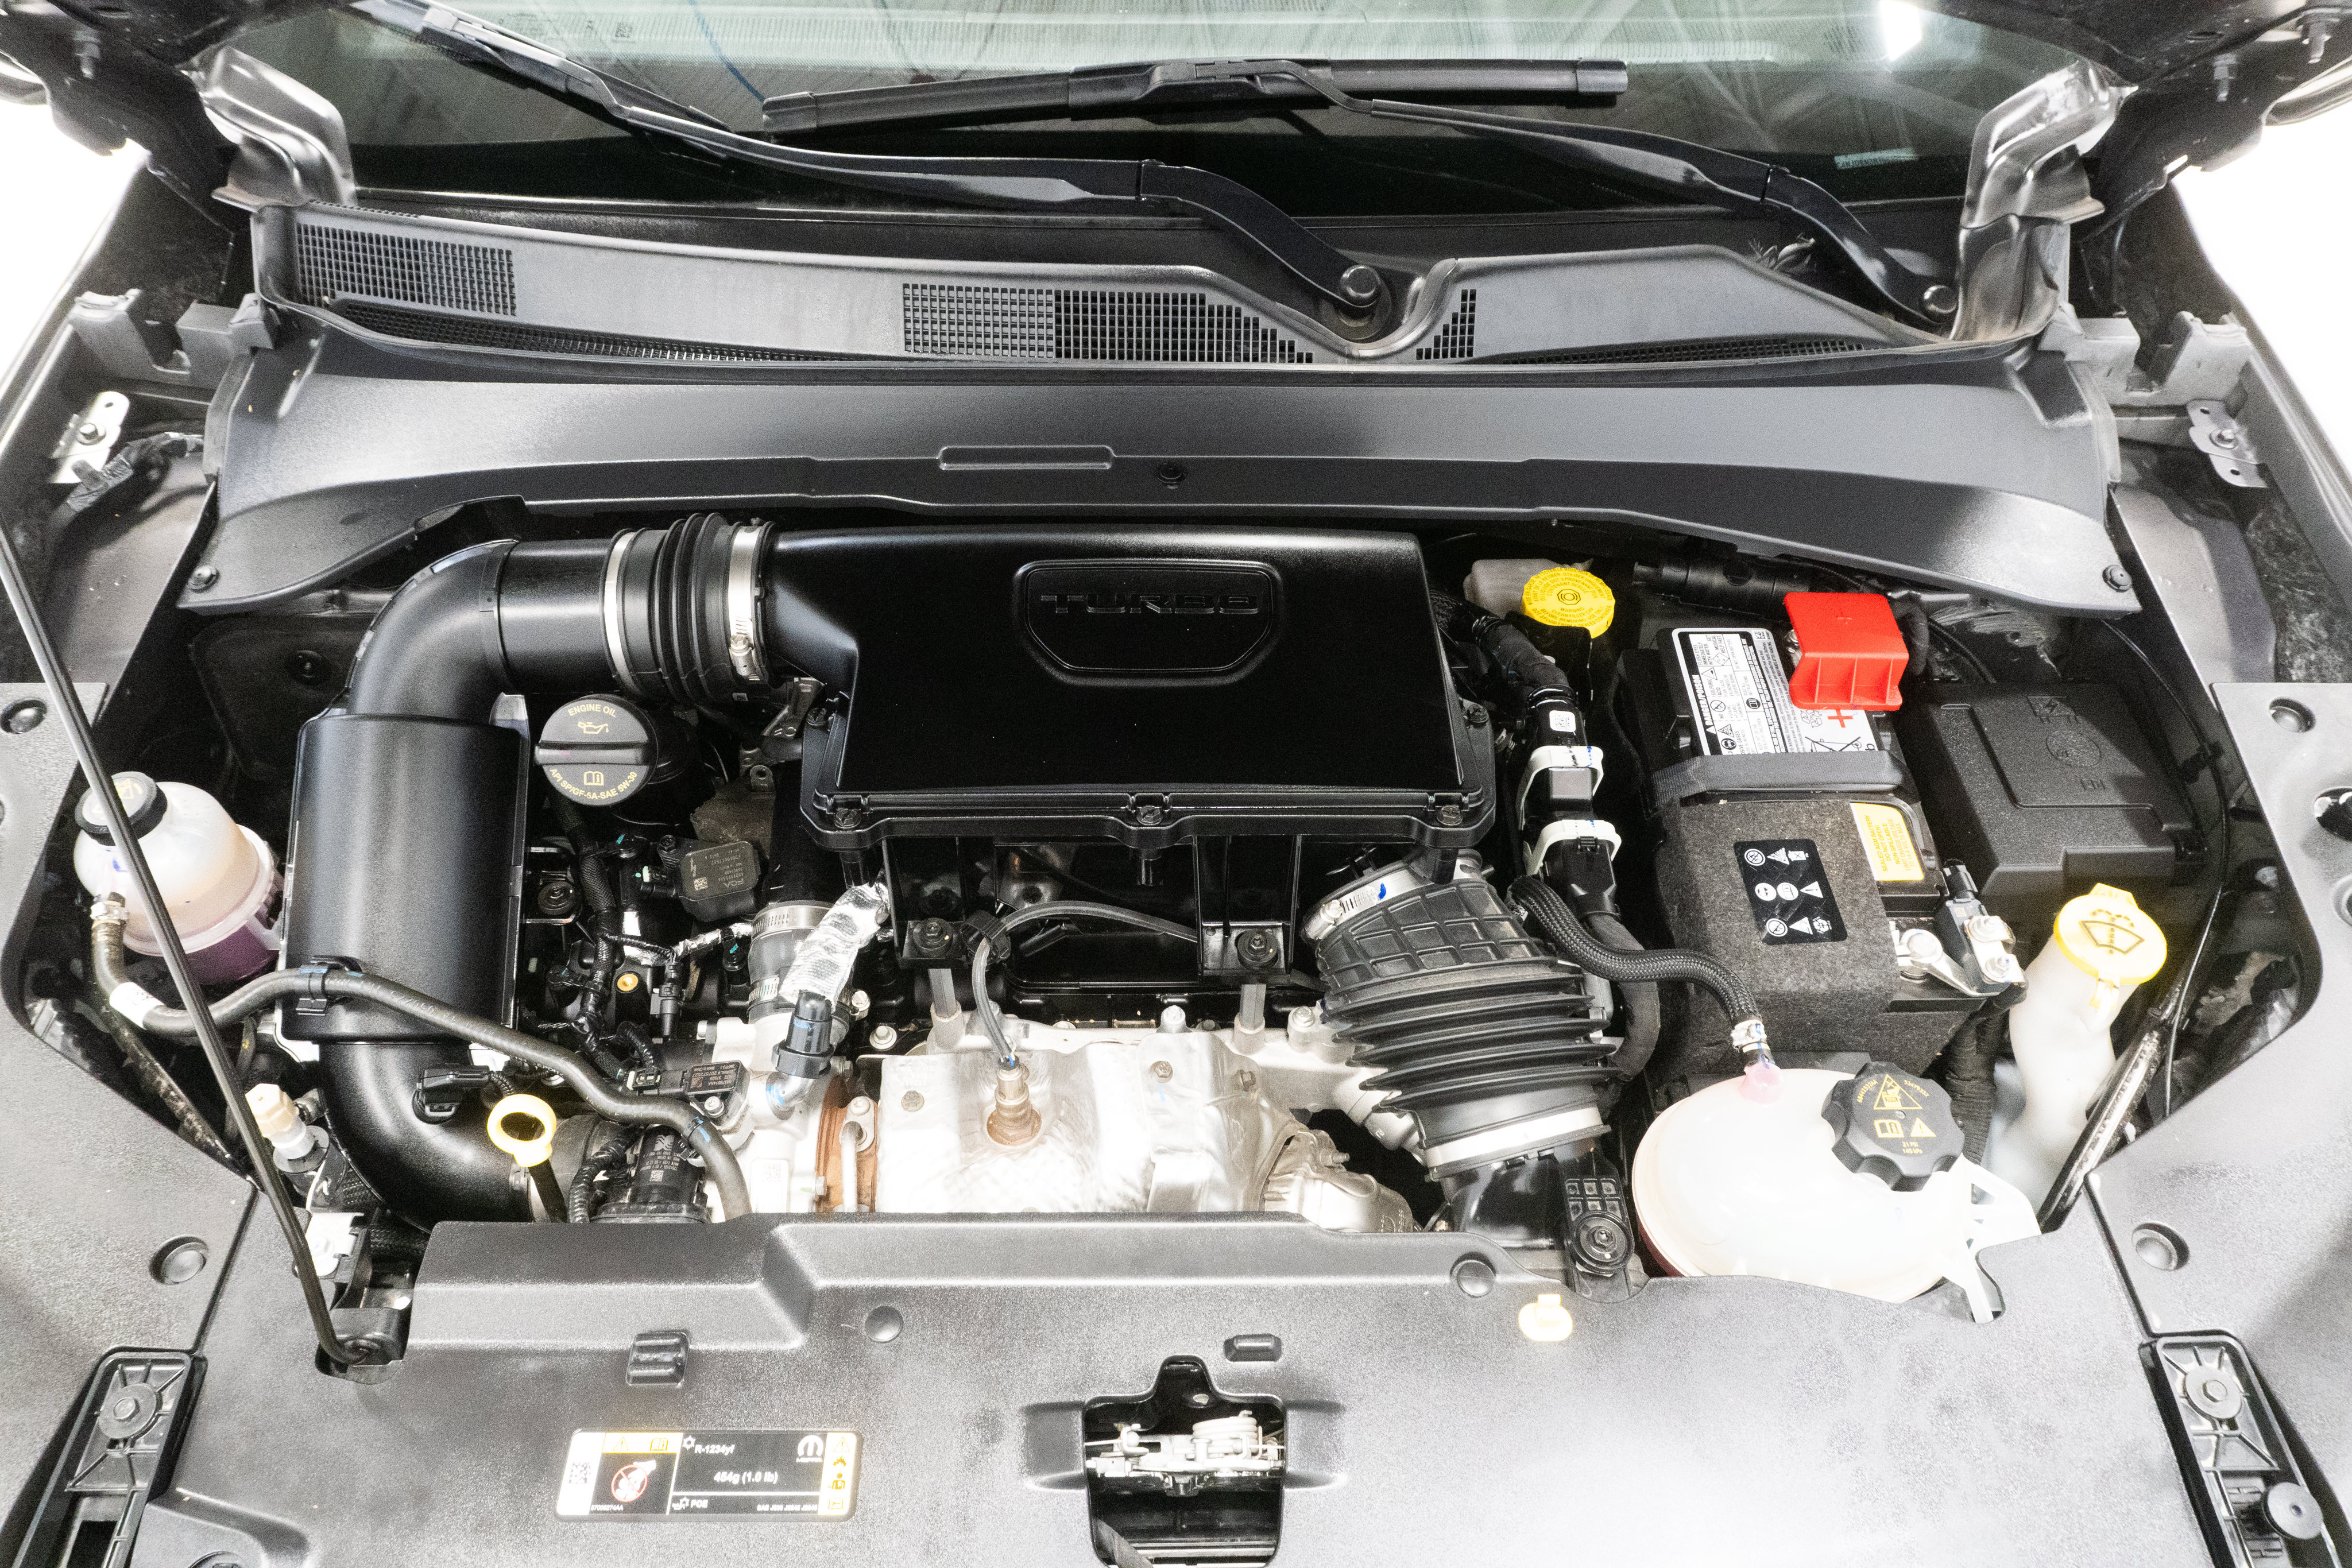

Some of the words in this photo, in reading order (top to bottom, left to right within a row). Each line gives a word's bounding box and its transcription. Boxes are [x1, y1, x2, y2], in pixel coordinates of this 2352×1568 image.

[1040, 594, 1258, 614] TURBO
[1697, 642, 1707, 665] IMMEDIATELY
[1693, 675, 1712, 725] DANGER/POISON
[568, 704, 601, 717] ENGINE
[602, 706, 617, 718] OIL
[550, 768, 563, 783] API
[560, 780, 618, 800] SP/GF-6A-SAE
[617, 772, 638, 792] 5W-30
[1864, 815, 1876, 837] BATTERY
[1887, 818, 1898, 838] VOLTAGE
[1882, 823, 1901, 864] NON-SPILLABLE
[1895, 840, 1905, 857] CHARGE
[1877, 851, 1888, 871] SEALED
[1902, 858, 1911, 870] LIMIT
[695, 1443, 734, 1455] R-1234yf
[713, 1471, 740, 1485] 454g
[741, 1471, 761, 1485] (1.0
[763, 1471, 778, 1485] lb)
[691, 1499, 708, 1509] POE
